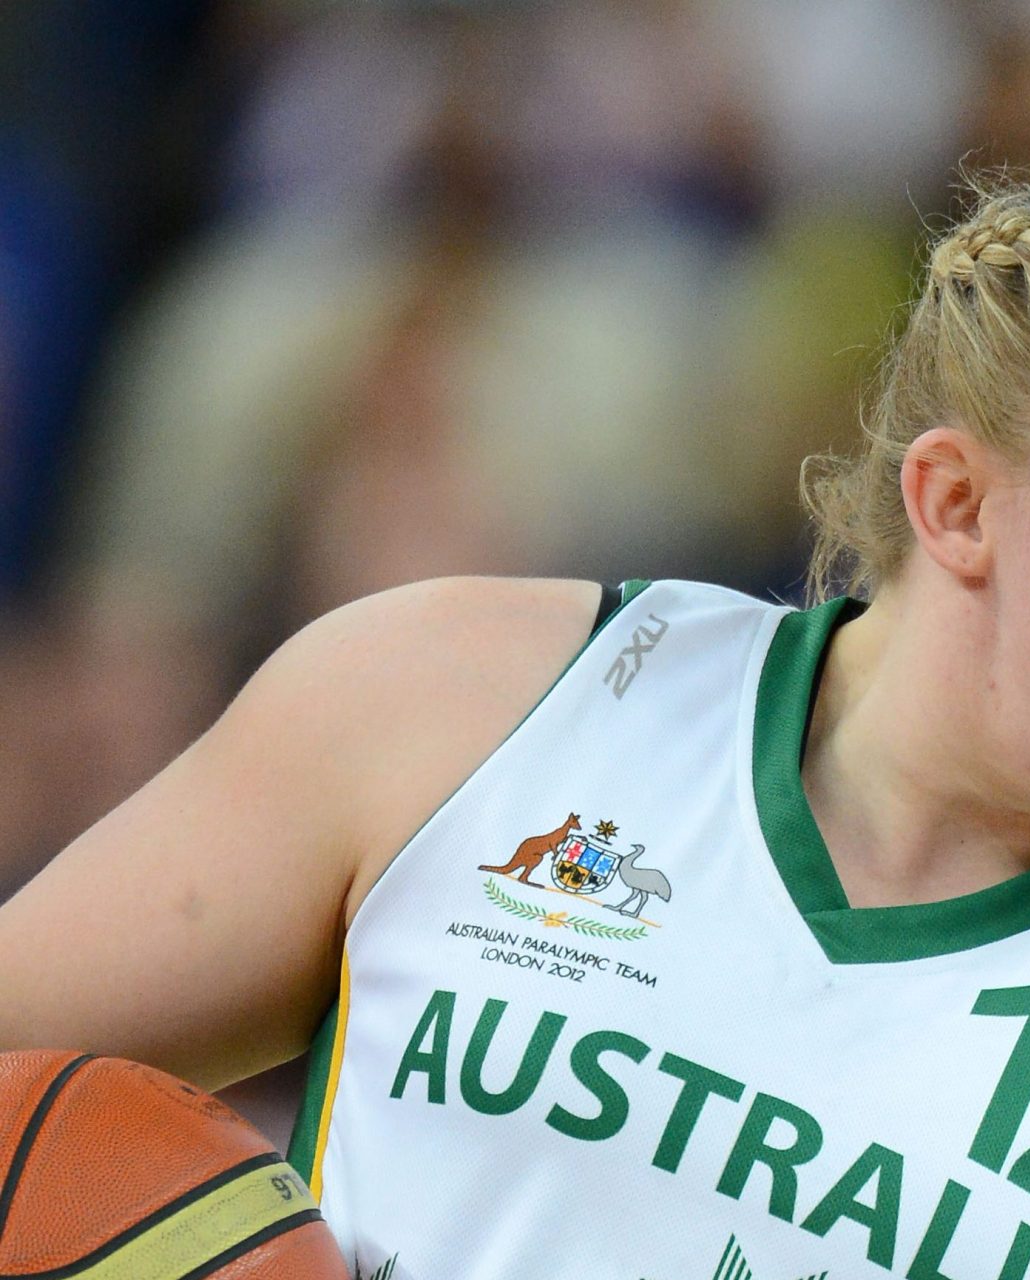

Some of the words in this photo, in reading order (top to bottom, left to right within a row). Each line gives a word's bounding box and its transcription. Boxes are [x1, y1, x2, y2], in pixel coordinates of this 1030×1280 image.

[603, 614, 670, 700] 2XU
[446, 921, 520, 946] AUSTRALIAN
[521, 936, 610, 971] PARALYMPIC
[615, 962, 658, 989] TEAM
[480, 946, 545, 971] LONDON
[547, 962, 586, 983] 2012
